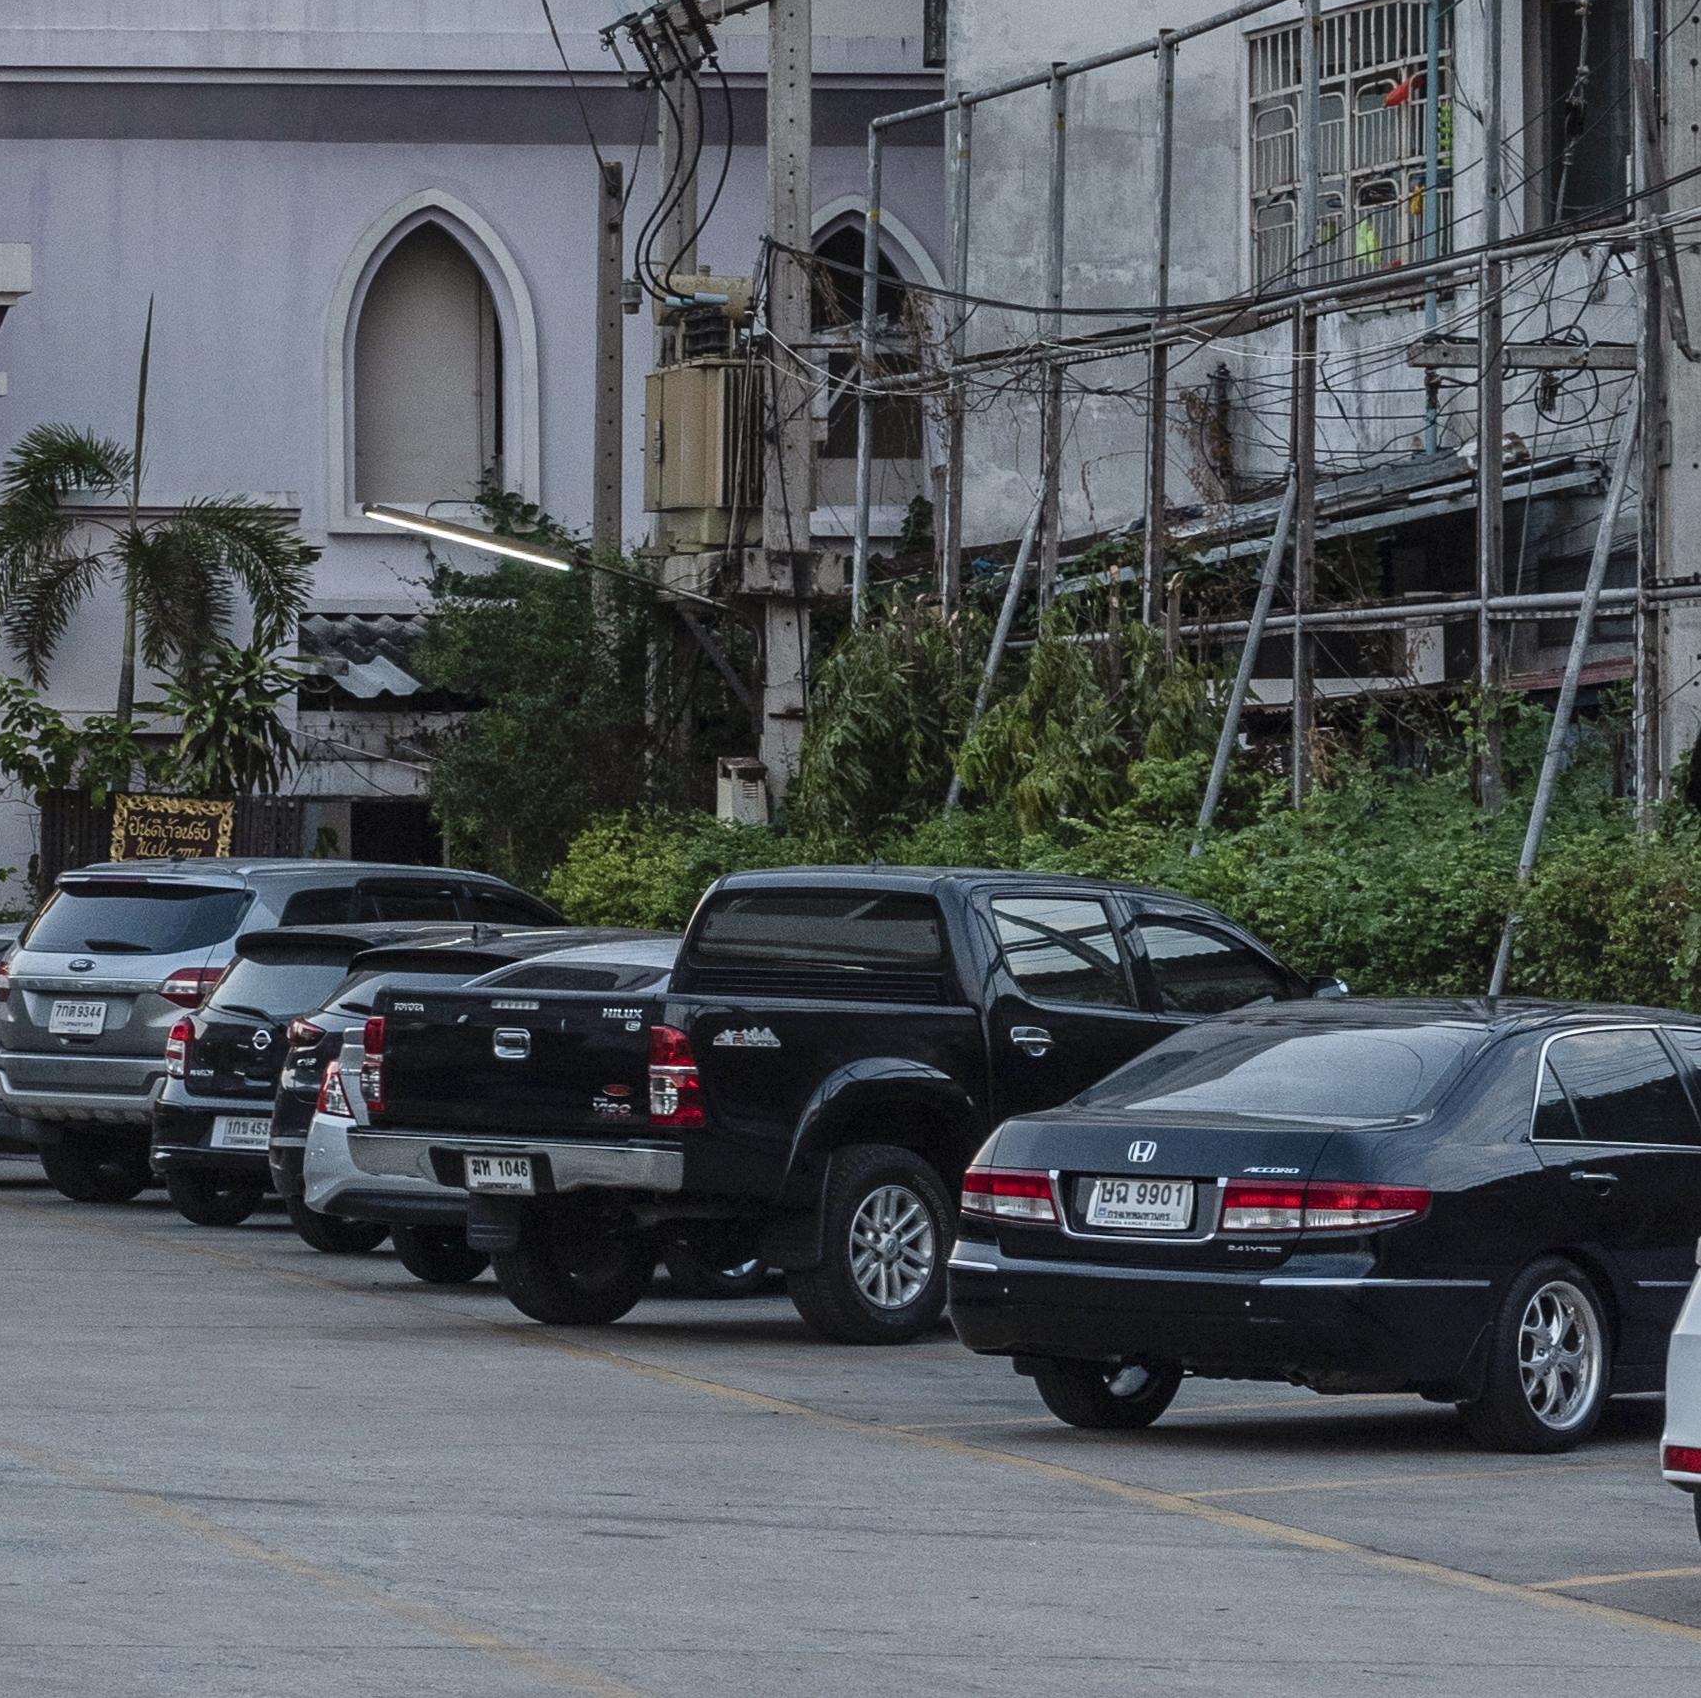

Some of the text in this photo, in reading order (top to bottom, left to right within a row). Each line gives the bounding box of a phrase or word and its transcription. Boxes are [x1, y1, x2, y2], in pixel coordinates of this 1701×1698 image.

[394, 1002, 424, 1012] TOYOTA
[602, 1008, 642, 1019] HILUX
[250, 1122, 271, 1135] 453
[498, 1160, 528, 1177] 1046
[1136, 1183, 1184, 1207] 9901
